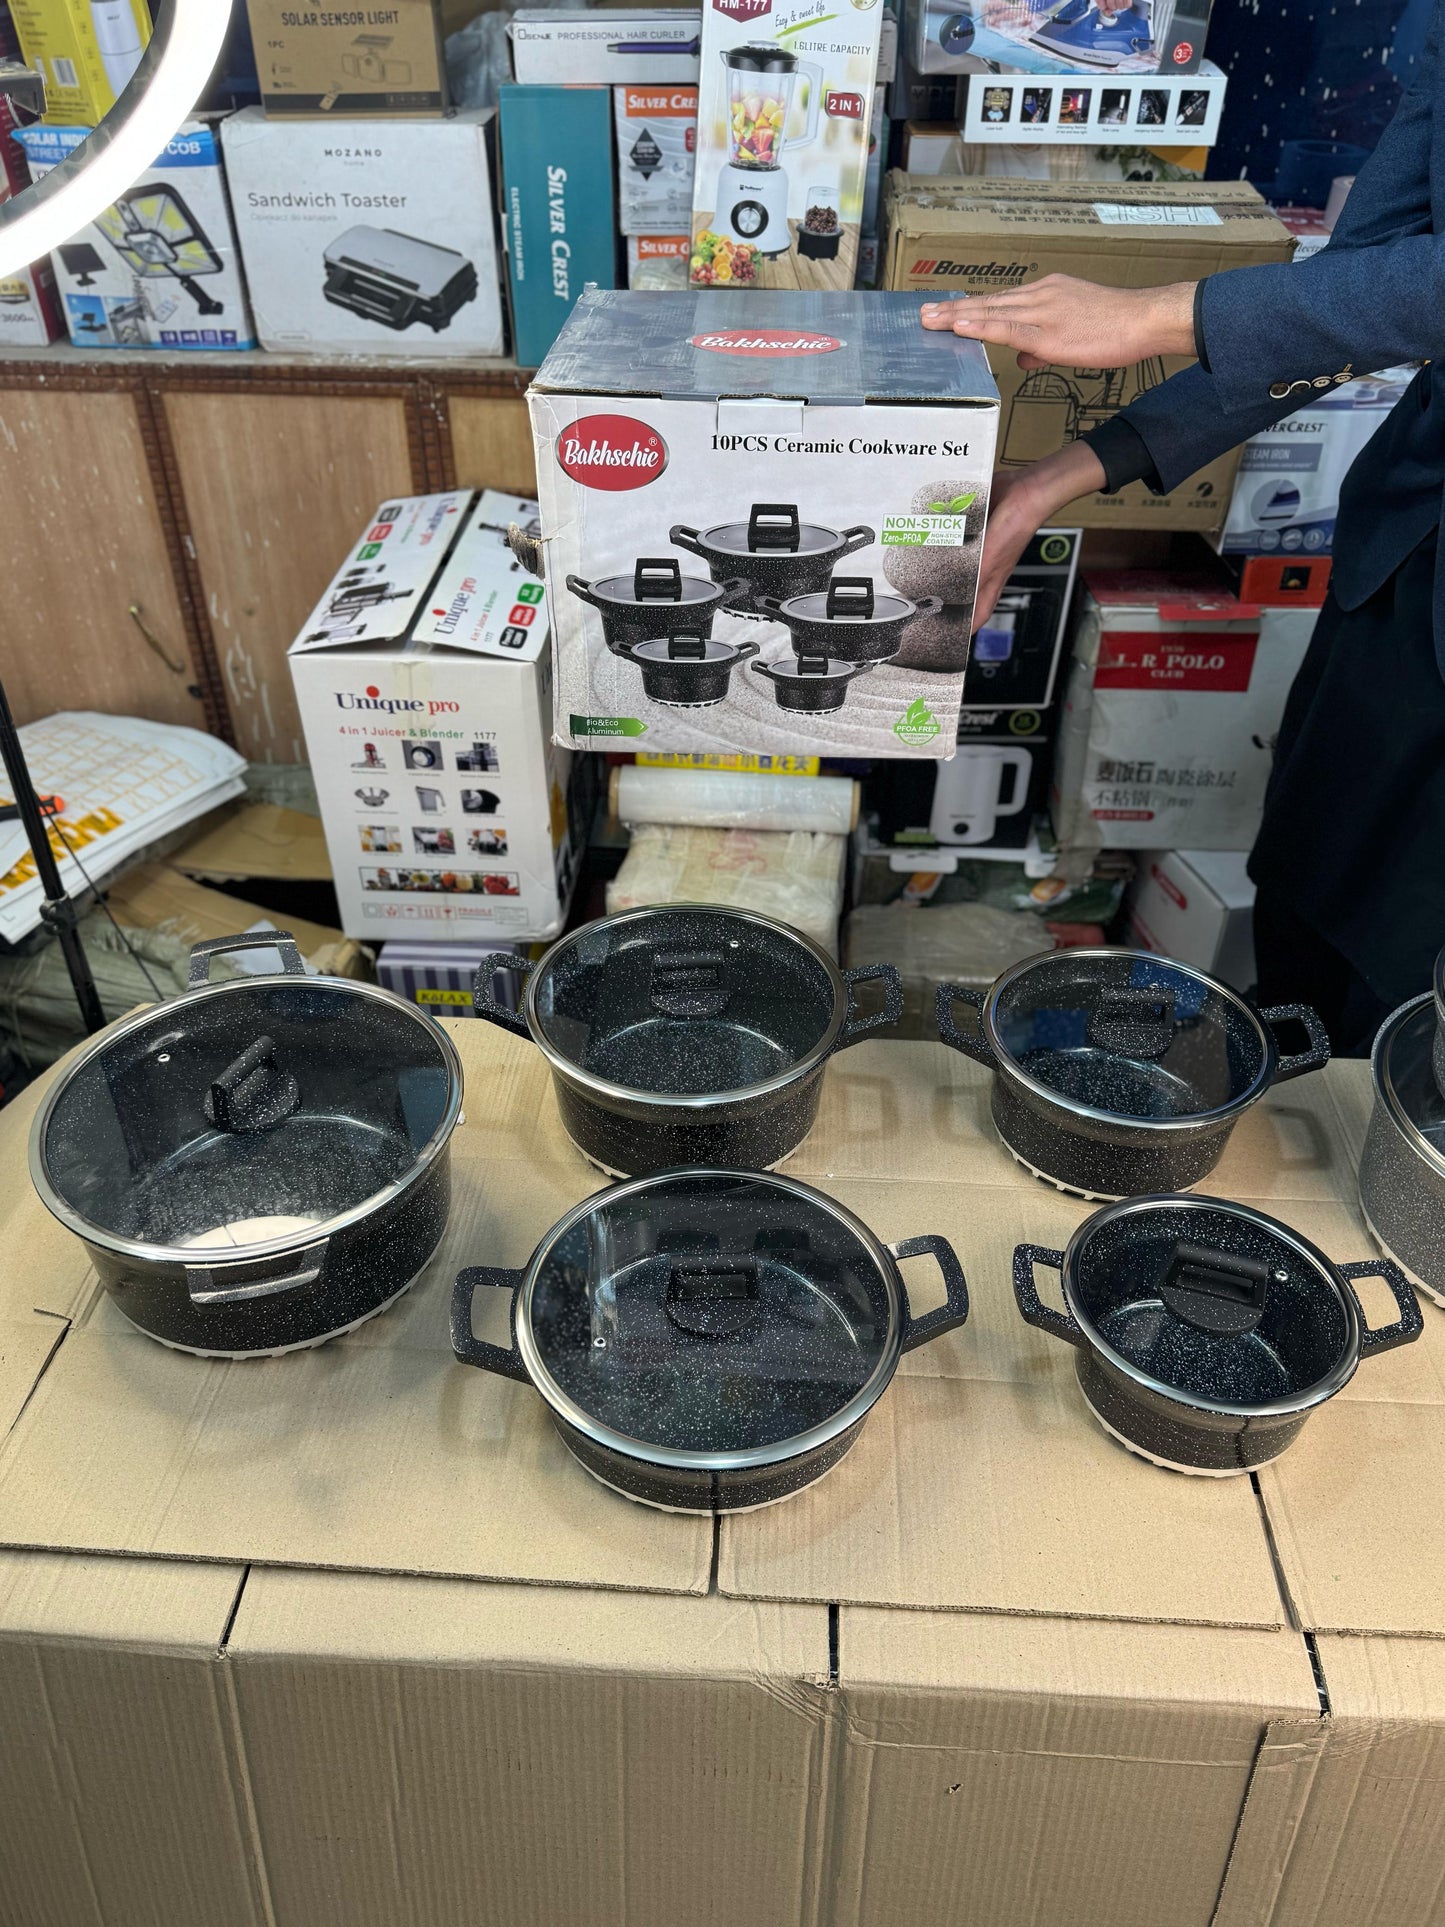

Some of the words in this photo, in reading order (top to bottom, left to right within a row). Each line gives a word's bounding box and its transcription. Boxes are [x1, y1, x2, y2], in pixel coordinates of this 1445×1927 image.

[719, 0, 767, 11] HM-177
[281, 12, 318, 26] SOLAR
[321, 11, 364, 25] SENSOR
[367, 10, 399, 24] LIGHT
[791, 10, 797, 22] &
[557, 31, 624, 40] PROFESSIONAL
[627, 31, 648, 40] HAIR
[650, 30, 686, 39] CURLER
[268, 40, 285, 48] 1PC
[830, 43, 871, 55] CAPACITY
[1176, 49, 1183, 59] 3
[628, 95, 667, 109] SILVER
[670, 94, 696, 109] CRE
[829, 99, 838, 111] 2
[840, 100, 852, 111] IN
[856, 101, 861, 112] 1
[22, 132, 57, 146] SOLAR
[324, 149, 382, 157] MOZANO
[248, 192, 336, 208] Sandwich
[340, 193, 407, 208] Toaster
[547, 165, 568, 235] SILVER
[511, 187, 522, 230] ELECTRIC
[513, 230, 523, 261] STEAM
[640, 240, 677, 254] SILVER
[515, 261, 524, 281] IRON
[551, 239, 571, 300] CREST
[933, 260, 1028, 277] Boodain
[965, 288, 985, 297] leaner
[700, 336, 831, 349] Bakhschie
[710, 434, 769, 453] 10PCS
[774, 436, 844, 455] Ceramic
[848, 437, 938, 458] Cookware
[941, 440, 969, 457] Set
[565, 439, 659, 468] Bakhschie
[885, 518, 962, 530] NON-STICK
[884, 533, 922, 543] Zero-PFOA
[432, 592, 471, 635] Unique
[460, 577, 477, 594] pro
[1141, 654, 1157, 668] R
[1166, 654, 1225, 670] POLO
[1150, 669, 1184, 679] CLUB
[334, 685, 424, 714] Unique
[428, 700, 460, 715] pro
[586, 718, 619, 727] Bio&Eco
[959, 711, 998, 726] Crest
[339, 726, 346, 736] 4
[349, 726, 360, 736] in
[362, 727, 368, 737] 1
[371, 727, 406, 738] Juicer
[409, 728, 417, 738] &
[419, 729, 464, 739] Blender
[474, 732, 496, 741] 1177
[587, 728, 624, 736] Aluminum
